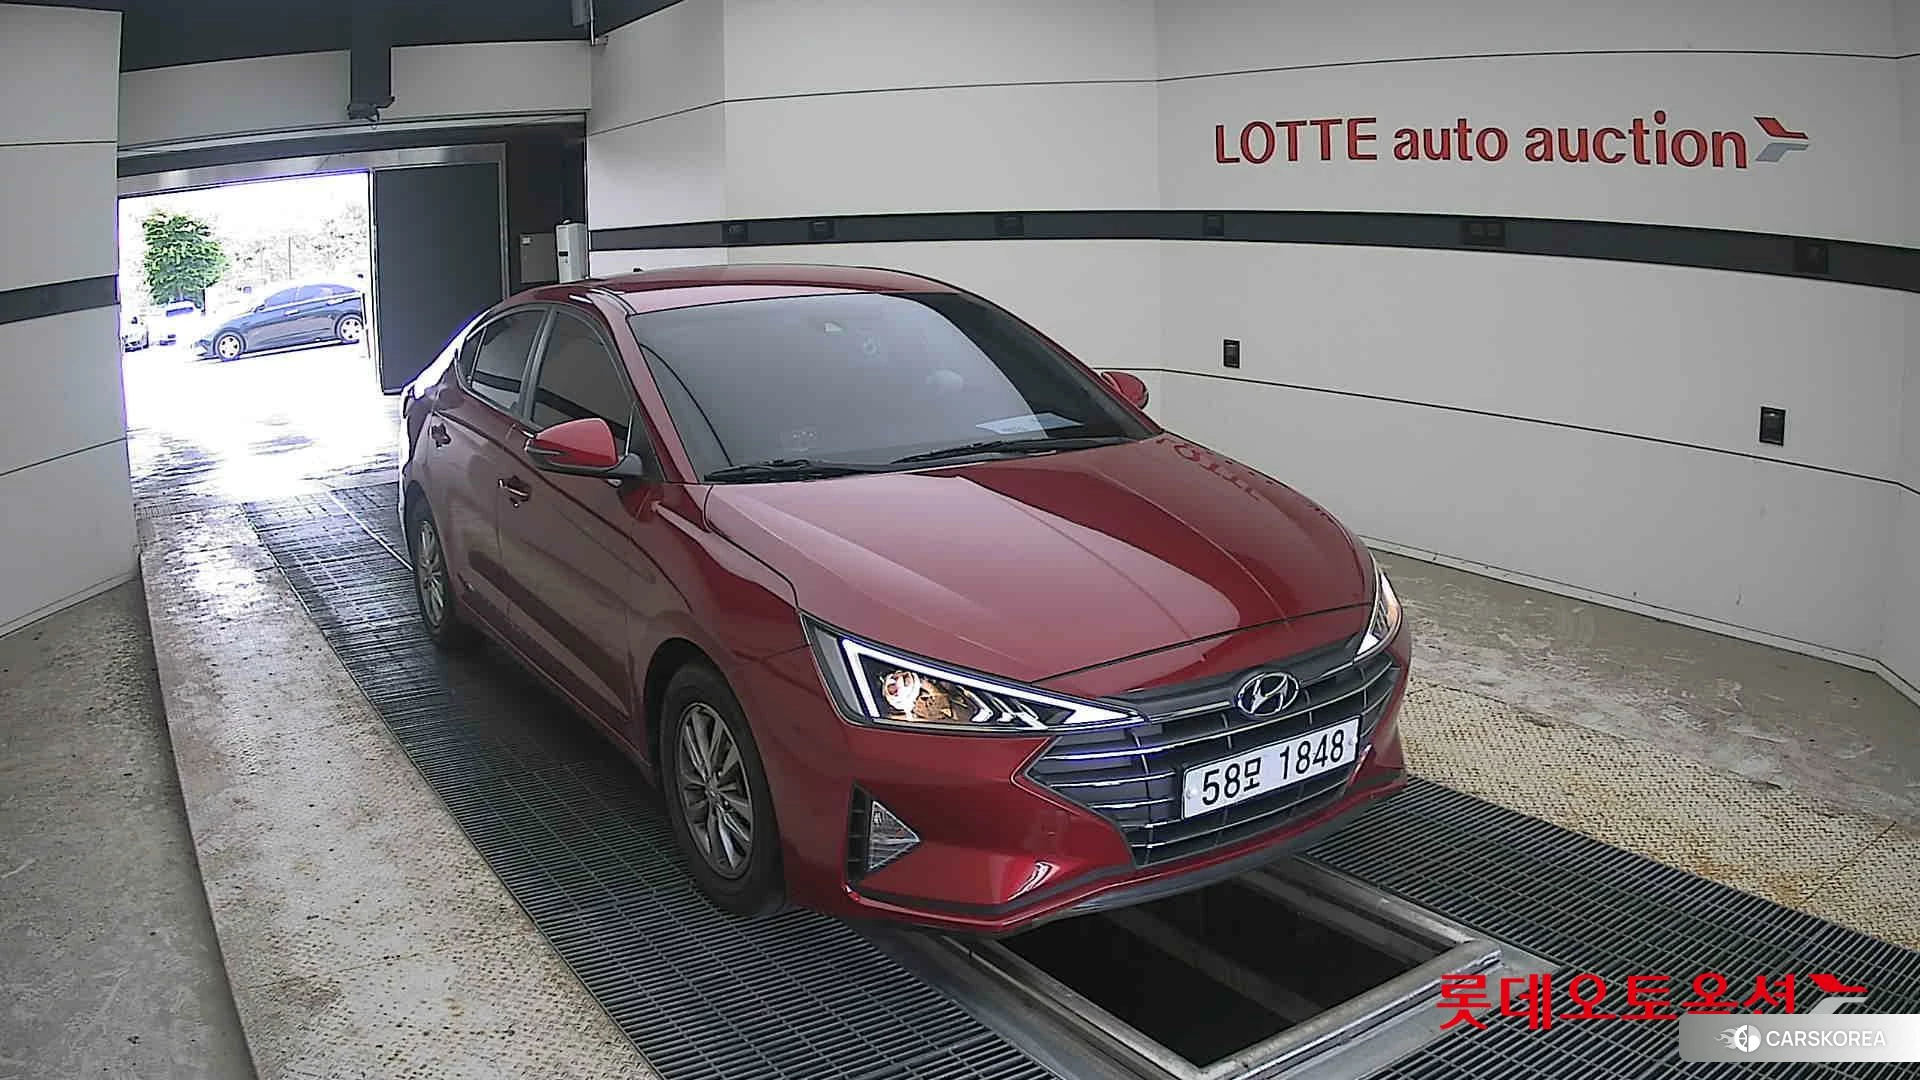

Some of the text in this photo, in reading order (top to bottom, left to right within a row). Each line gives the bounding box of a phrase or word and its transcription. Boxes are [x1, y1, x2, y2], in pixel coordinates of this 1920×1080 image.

[1215, 109, 1748, 169] LOTTE auto auction
[1201, 729, 1345, 806] 58모 1848
